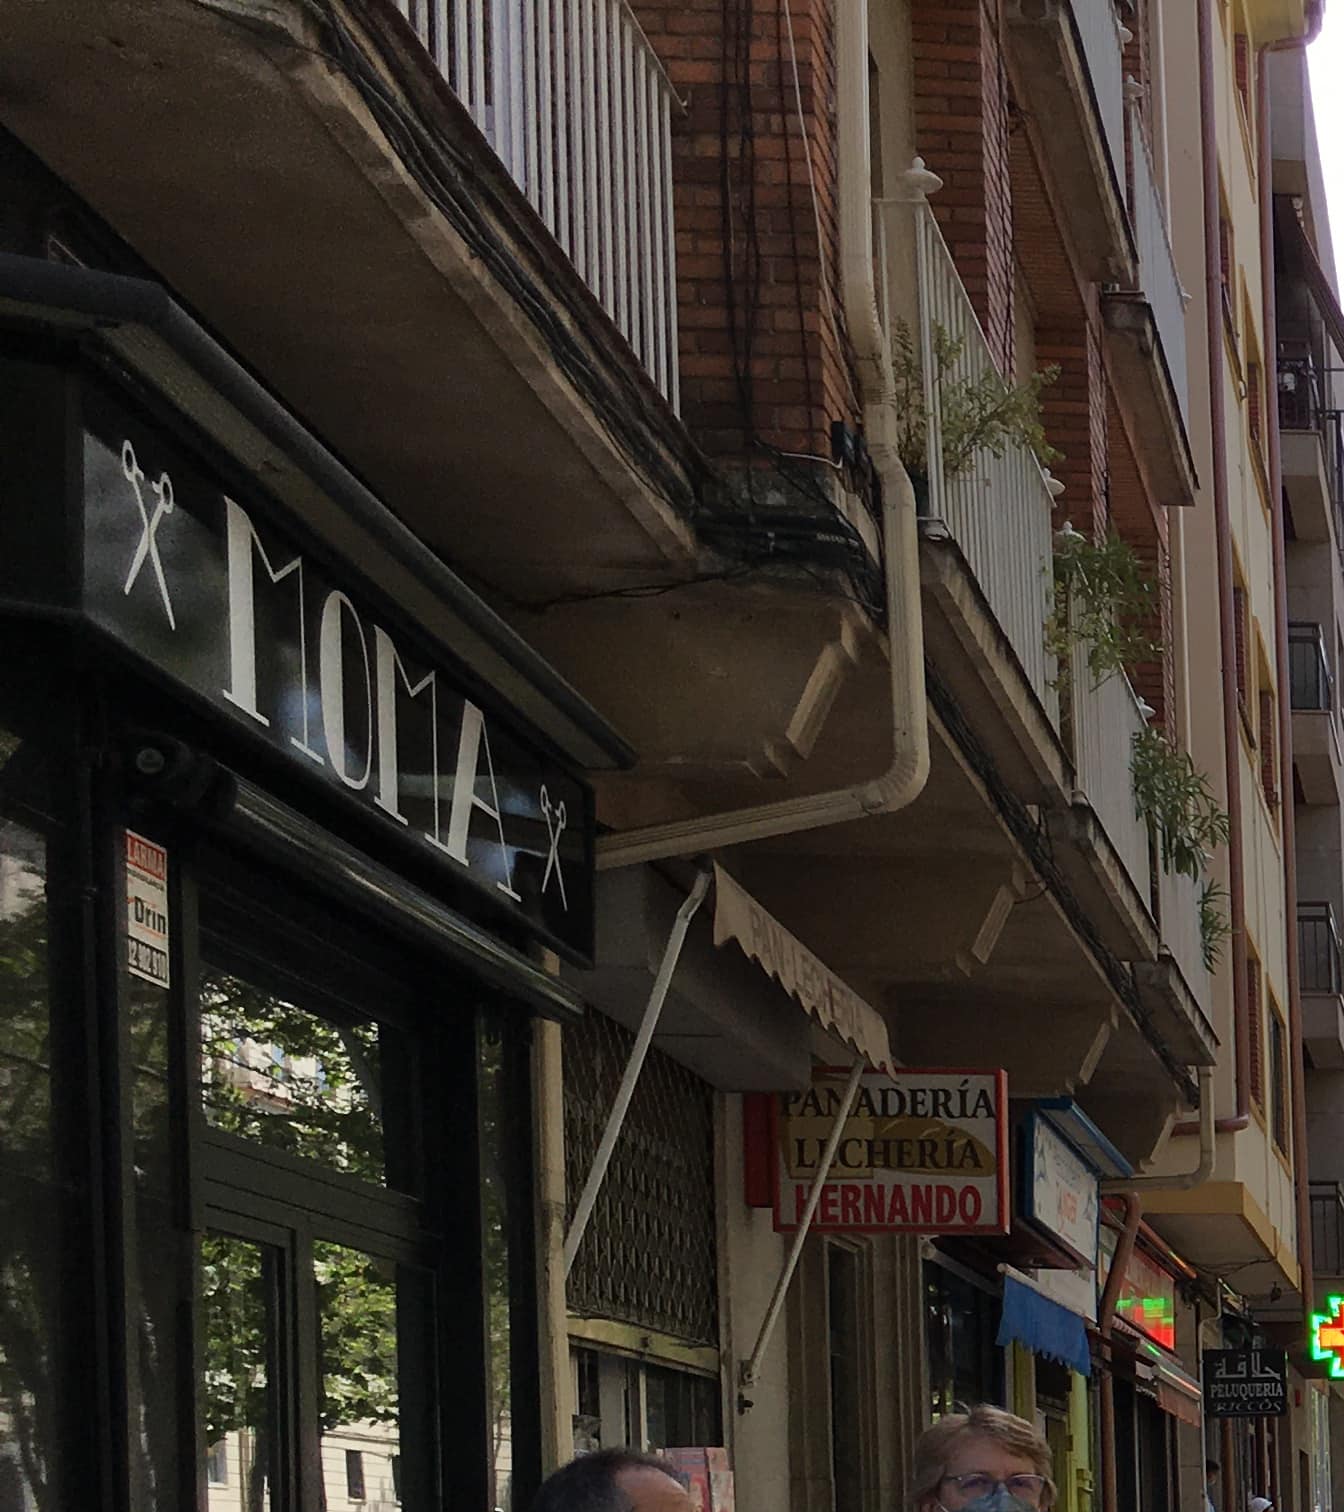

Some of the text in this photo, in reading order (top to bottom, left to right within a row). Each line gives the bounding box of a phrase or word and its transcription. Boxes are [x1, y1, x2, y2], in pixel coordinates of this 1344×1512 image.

[222, 494, 522, 904] MOMA
[779, 1077, 997, 1119] PANADERÍA
[795, 1183, 982, 1225] HERNANDO
[1210, 1382, 1284, 1401] PELUQUERIA
